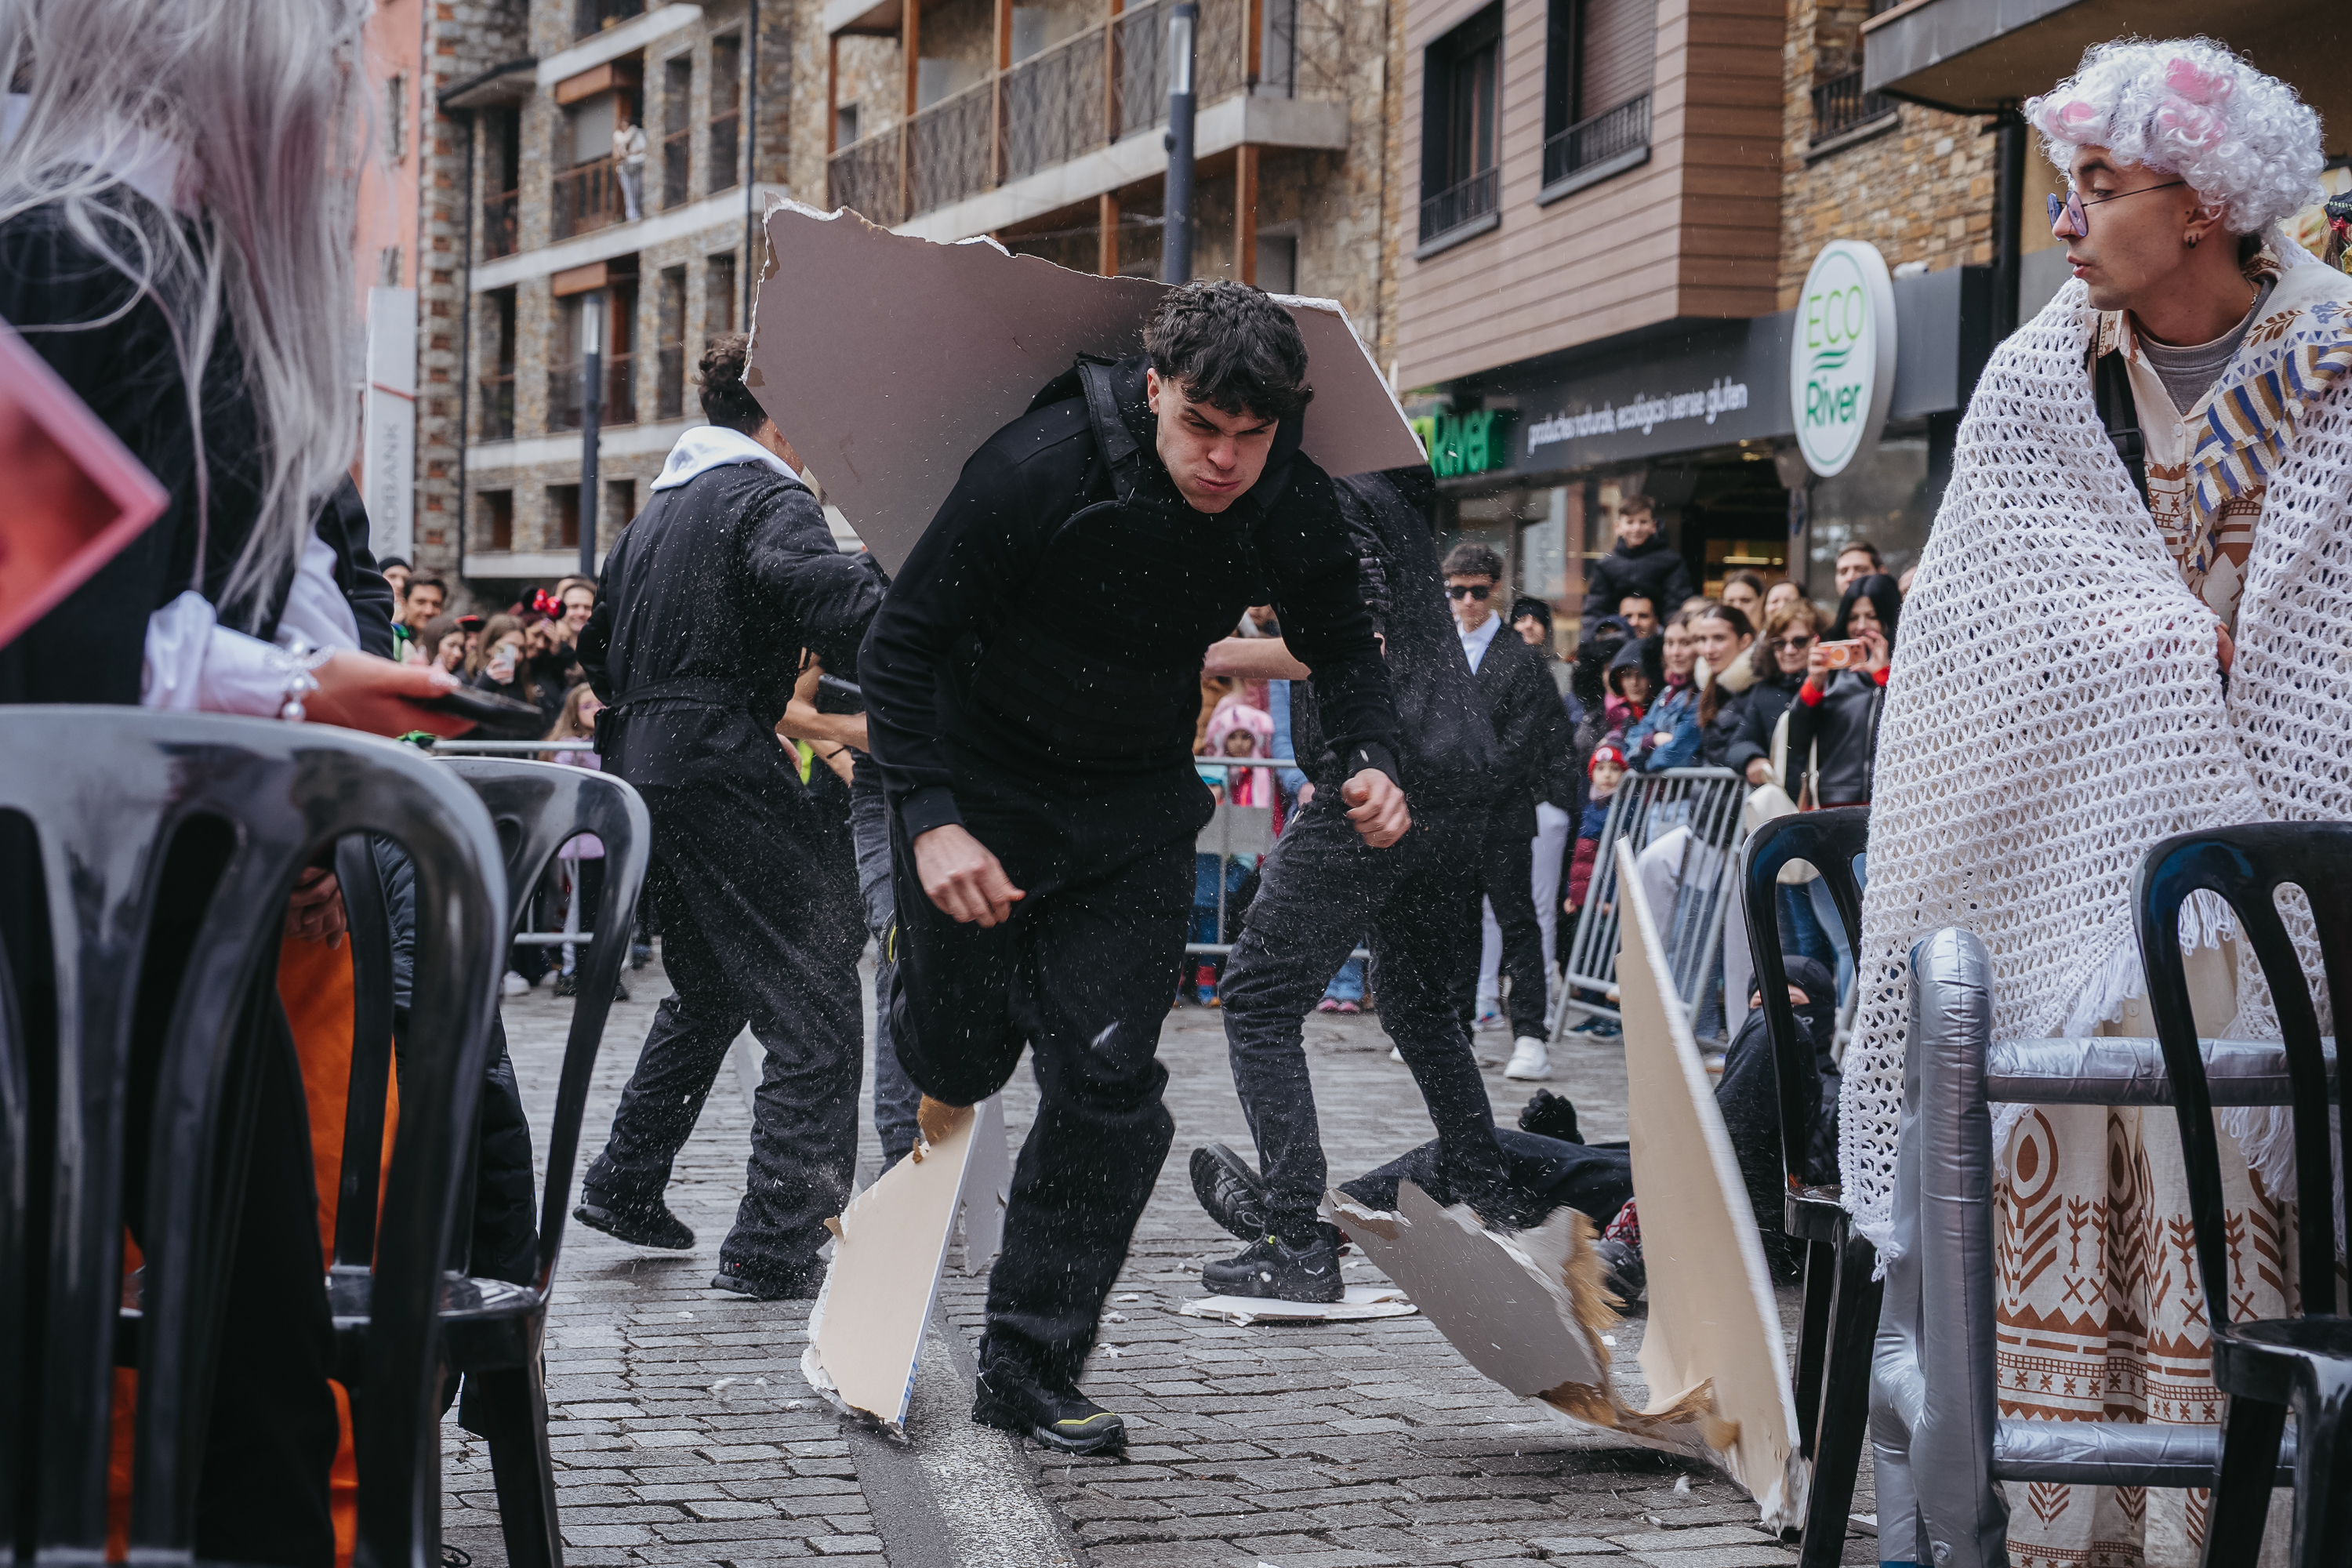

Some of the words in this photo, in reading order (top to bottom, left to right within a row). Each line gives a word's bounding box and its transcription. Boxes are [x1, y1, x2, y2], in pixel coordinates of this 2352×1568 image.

[1808, 285, 1865, 349] ECO
[1671, 390, 1705, 420] sense
[1705, 375, 1748, 426] gluten
[1806, 374, 1862, 428] River
[1432, 403, 1494, 477] River
